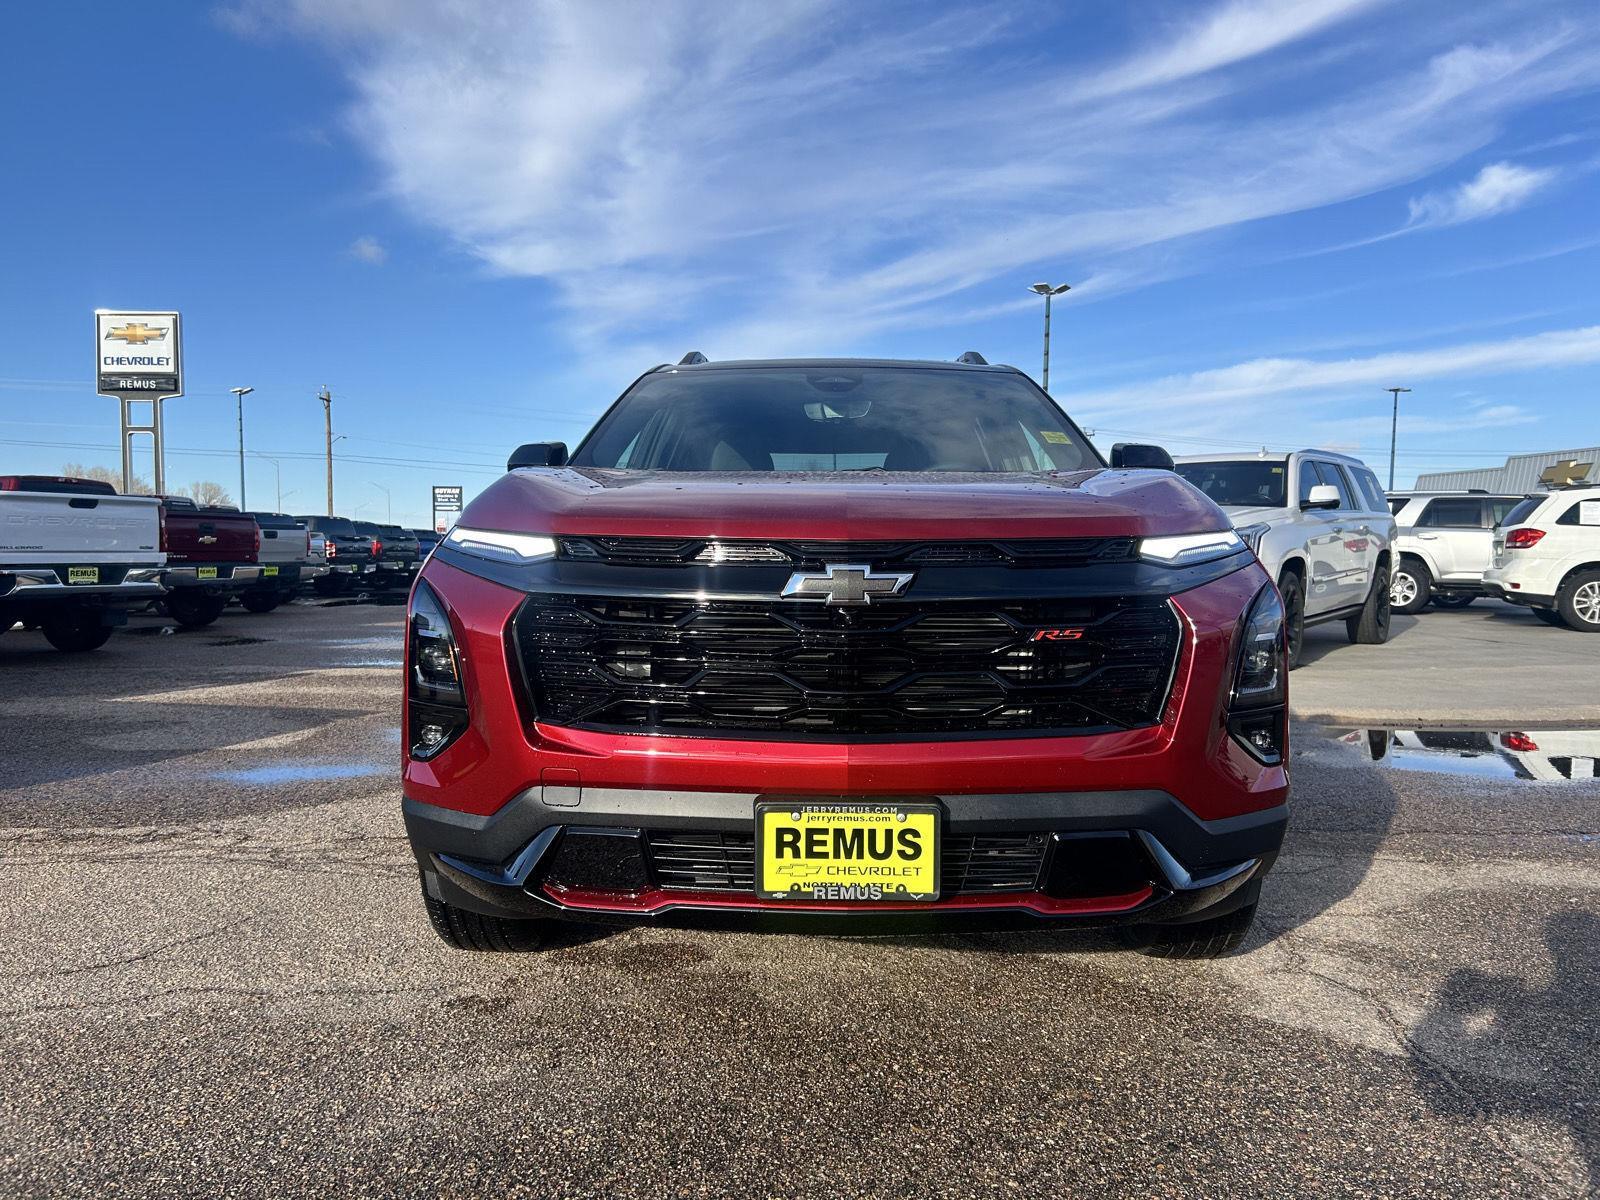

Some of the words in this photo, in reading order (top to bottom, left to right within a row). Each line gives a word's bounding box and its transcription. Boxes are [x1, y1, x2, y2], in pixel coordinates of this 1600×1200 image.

[104, 356, 171, 366] CHEVROLET
[120, 380, 156, 389] REMUS
[7, 515, 151, 528] CHEVROLET
[1034, 627, 1086, 641] RS
[800, 806, 898, 814] JERRYREMUS.COM
[807, 814, 891, 823] jerryremus.com
[775, 827, 923, 861] REMUS
[827, 866, 922, 876] CHEVROLET
[813, 886, 882, 900] REMUS
